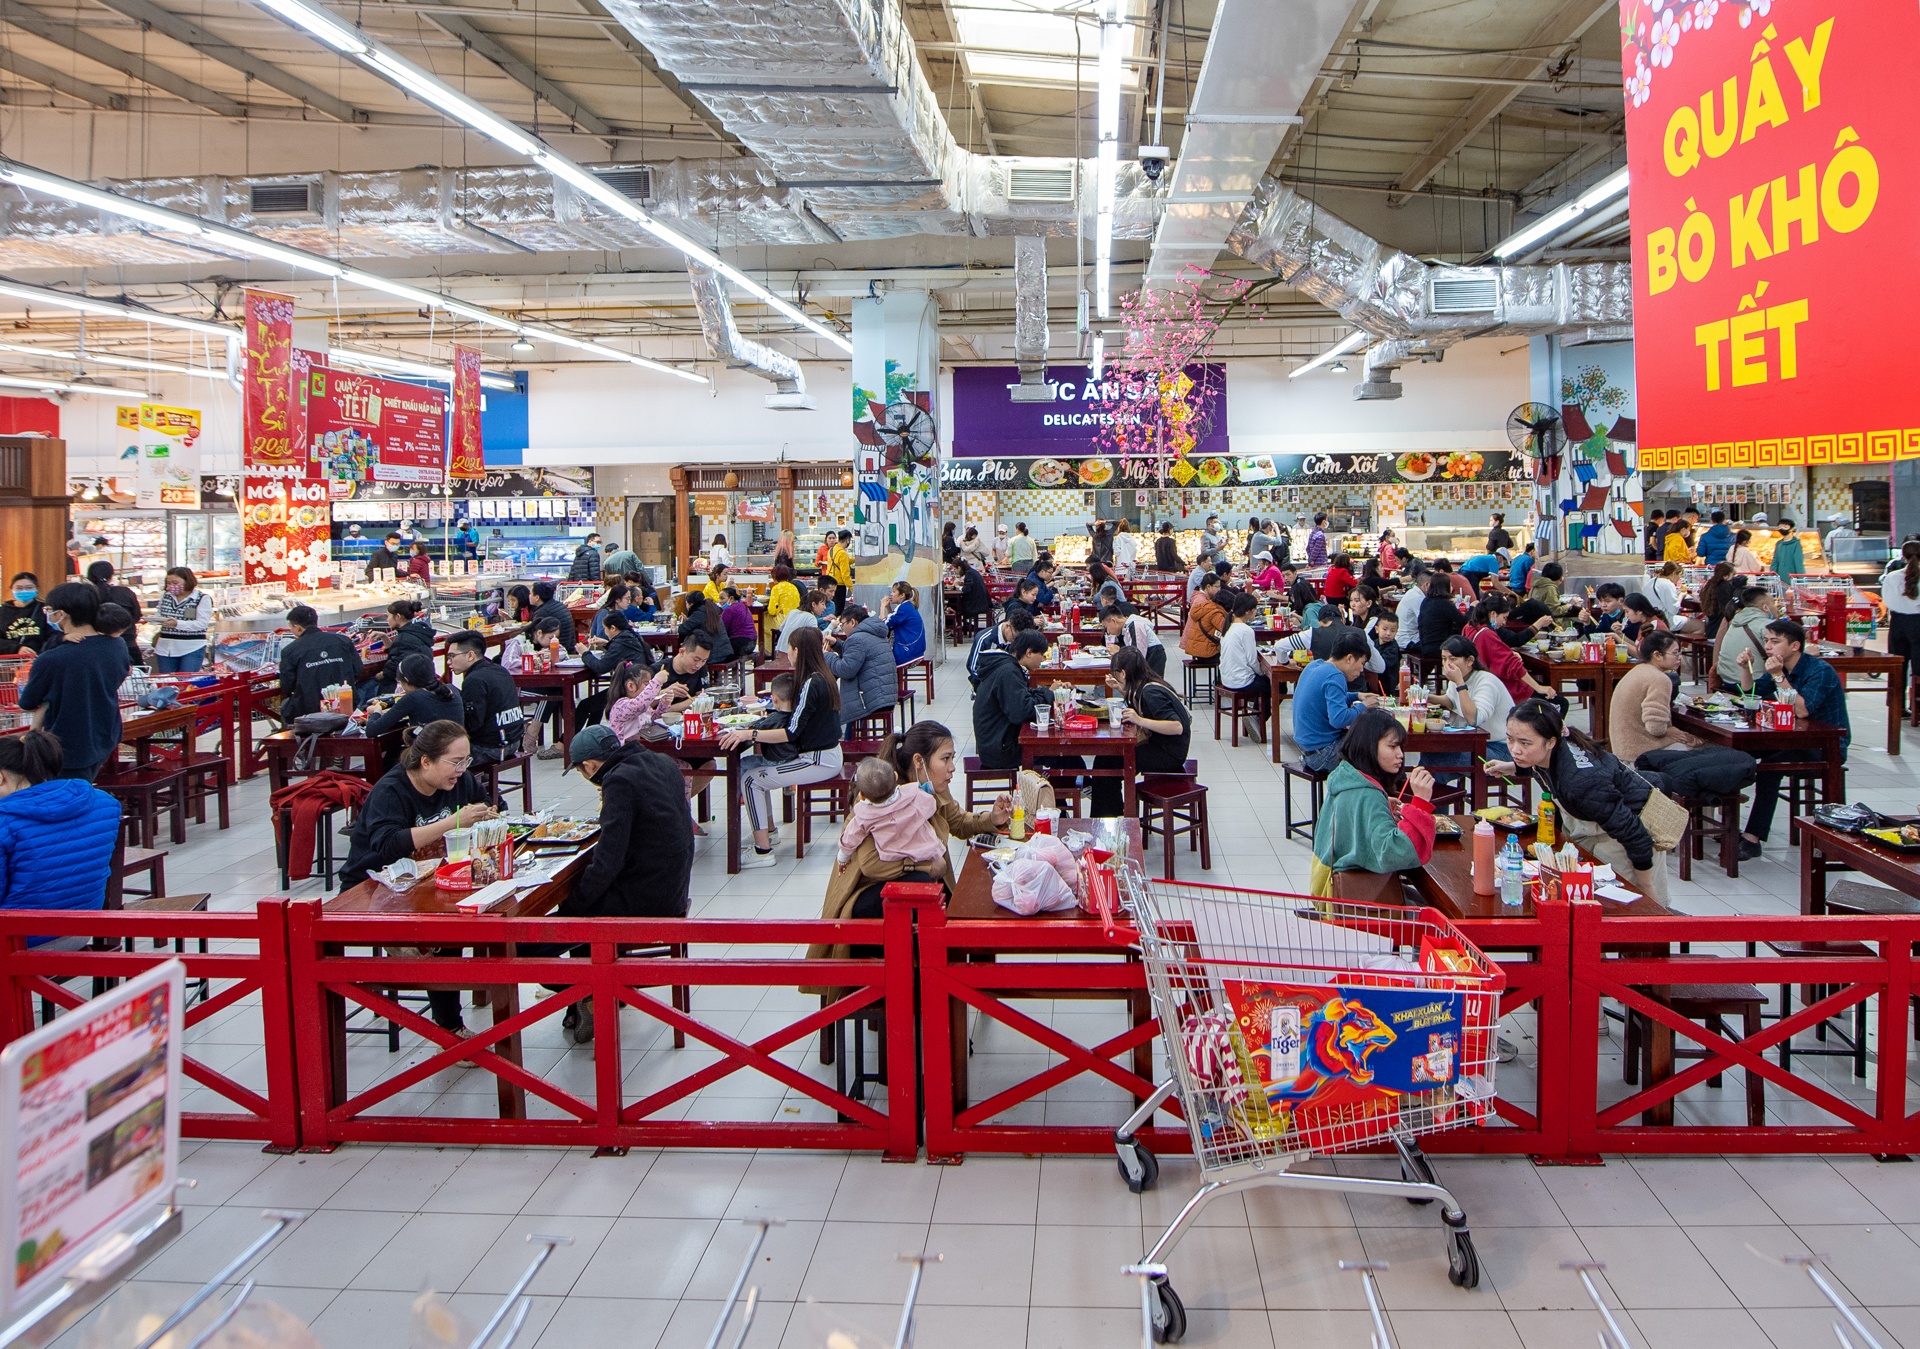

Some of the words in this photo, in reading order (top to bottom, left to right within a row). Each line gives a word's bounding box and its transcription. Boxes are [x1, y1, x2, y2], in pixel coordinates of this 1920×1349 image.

[1663, 16, 1835, 177] QUẦY
[1647, 196, 1715, 296] BÒ
[1729, 126, 1879, 269] KHÔ
[1695, 281, 1809, 392] TẾT
[335, 377, 353, 393] QUÀ
[343, 391, 369, 419] TẾT
[941, 461, 974, 481] Bún
[977, 460, 1018, 481] Phở
[1347, 454, 1380, 474] Xôi
